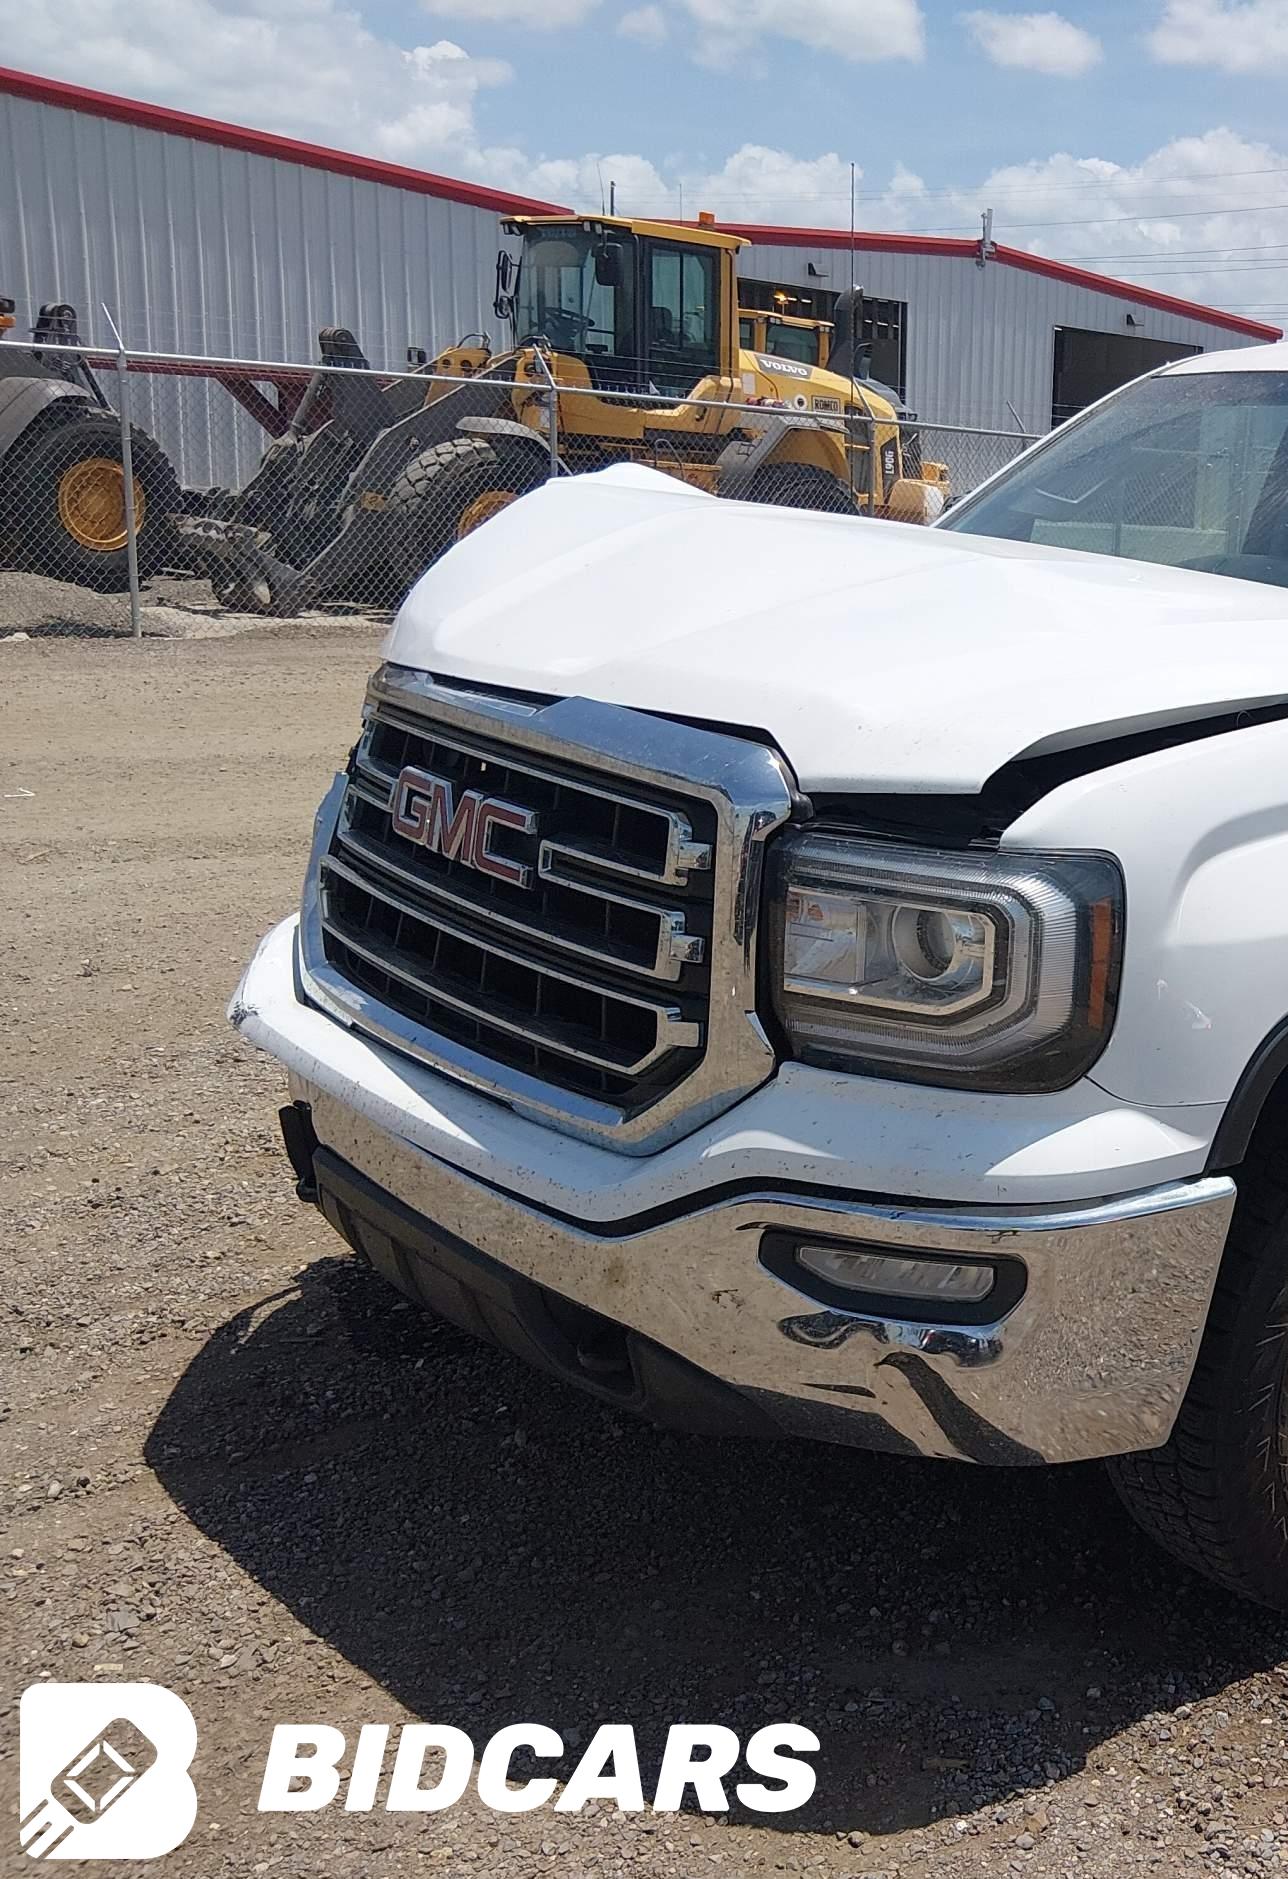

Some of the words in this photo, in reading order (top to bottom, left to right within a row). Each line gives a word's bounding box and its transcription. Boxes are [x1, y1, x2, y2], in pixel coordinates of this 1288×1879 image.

[760, 360, 808, 376] VOLVO
[884, 450, 895, 475] L90G
[392, 765, 538, 890] GMC
